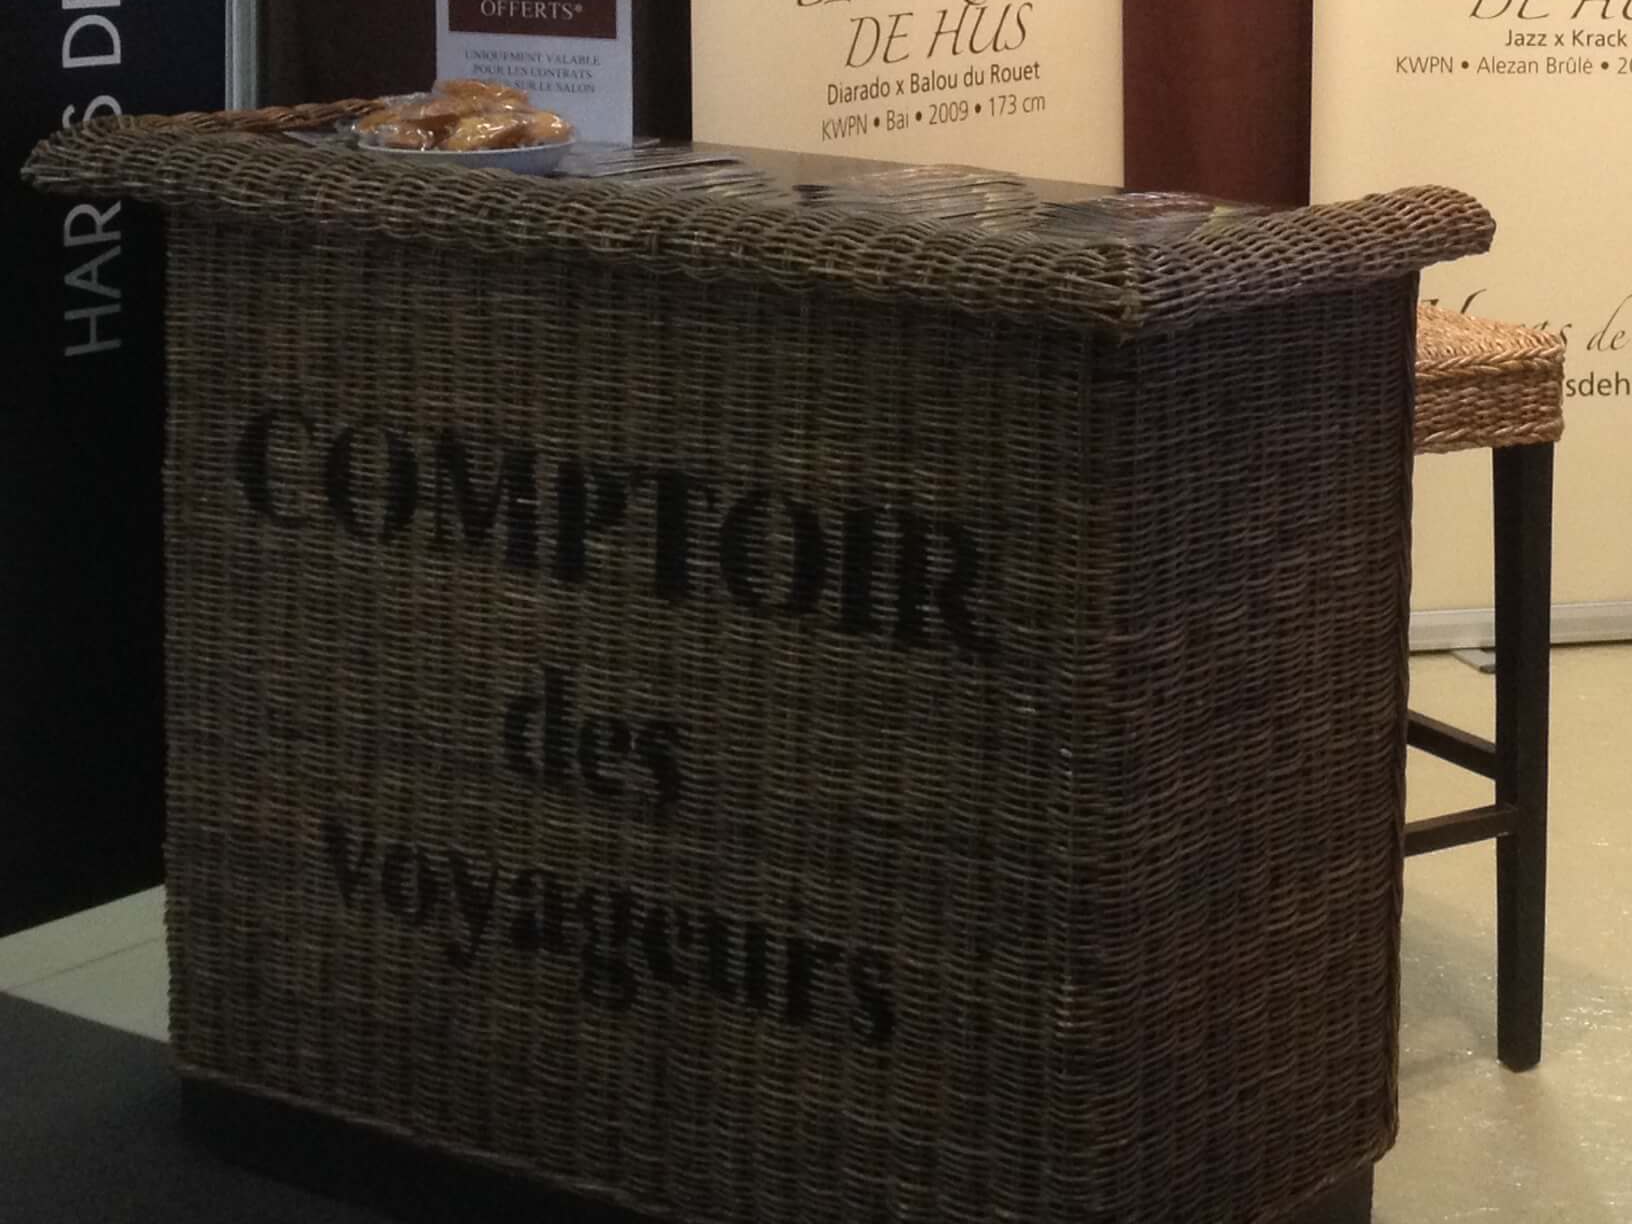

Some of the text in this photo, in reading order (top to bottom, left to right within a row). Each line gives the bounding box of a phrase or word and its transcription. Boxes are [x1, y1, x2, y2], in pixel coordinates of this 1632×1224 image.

[845, 2, 1034, 68] DE HUS
[1396, 57, 1453, 75] KWPN
[1476, 56, 1539, 75] Alezan
[1546, 55, 1594, 75] Brûlé
[1505, 29, 1548, 48] Jazz
[1554, 34, 1565, 47] x
[1572, 29, 1627, 48] Krack
[827, 61, 1041, 105] Diarado x Balou du Rouet
[821, 94, 1046, 142] KWPN Bai 2009 173 cm
[62, 95, 122, 357] HARS
[236, 407, 998, 662] COMPTOIR
[503, 665, 687, 812] des
[322, 813, 898, 1046] Voyageurs
